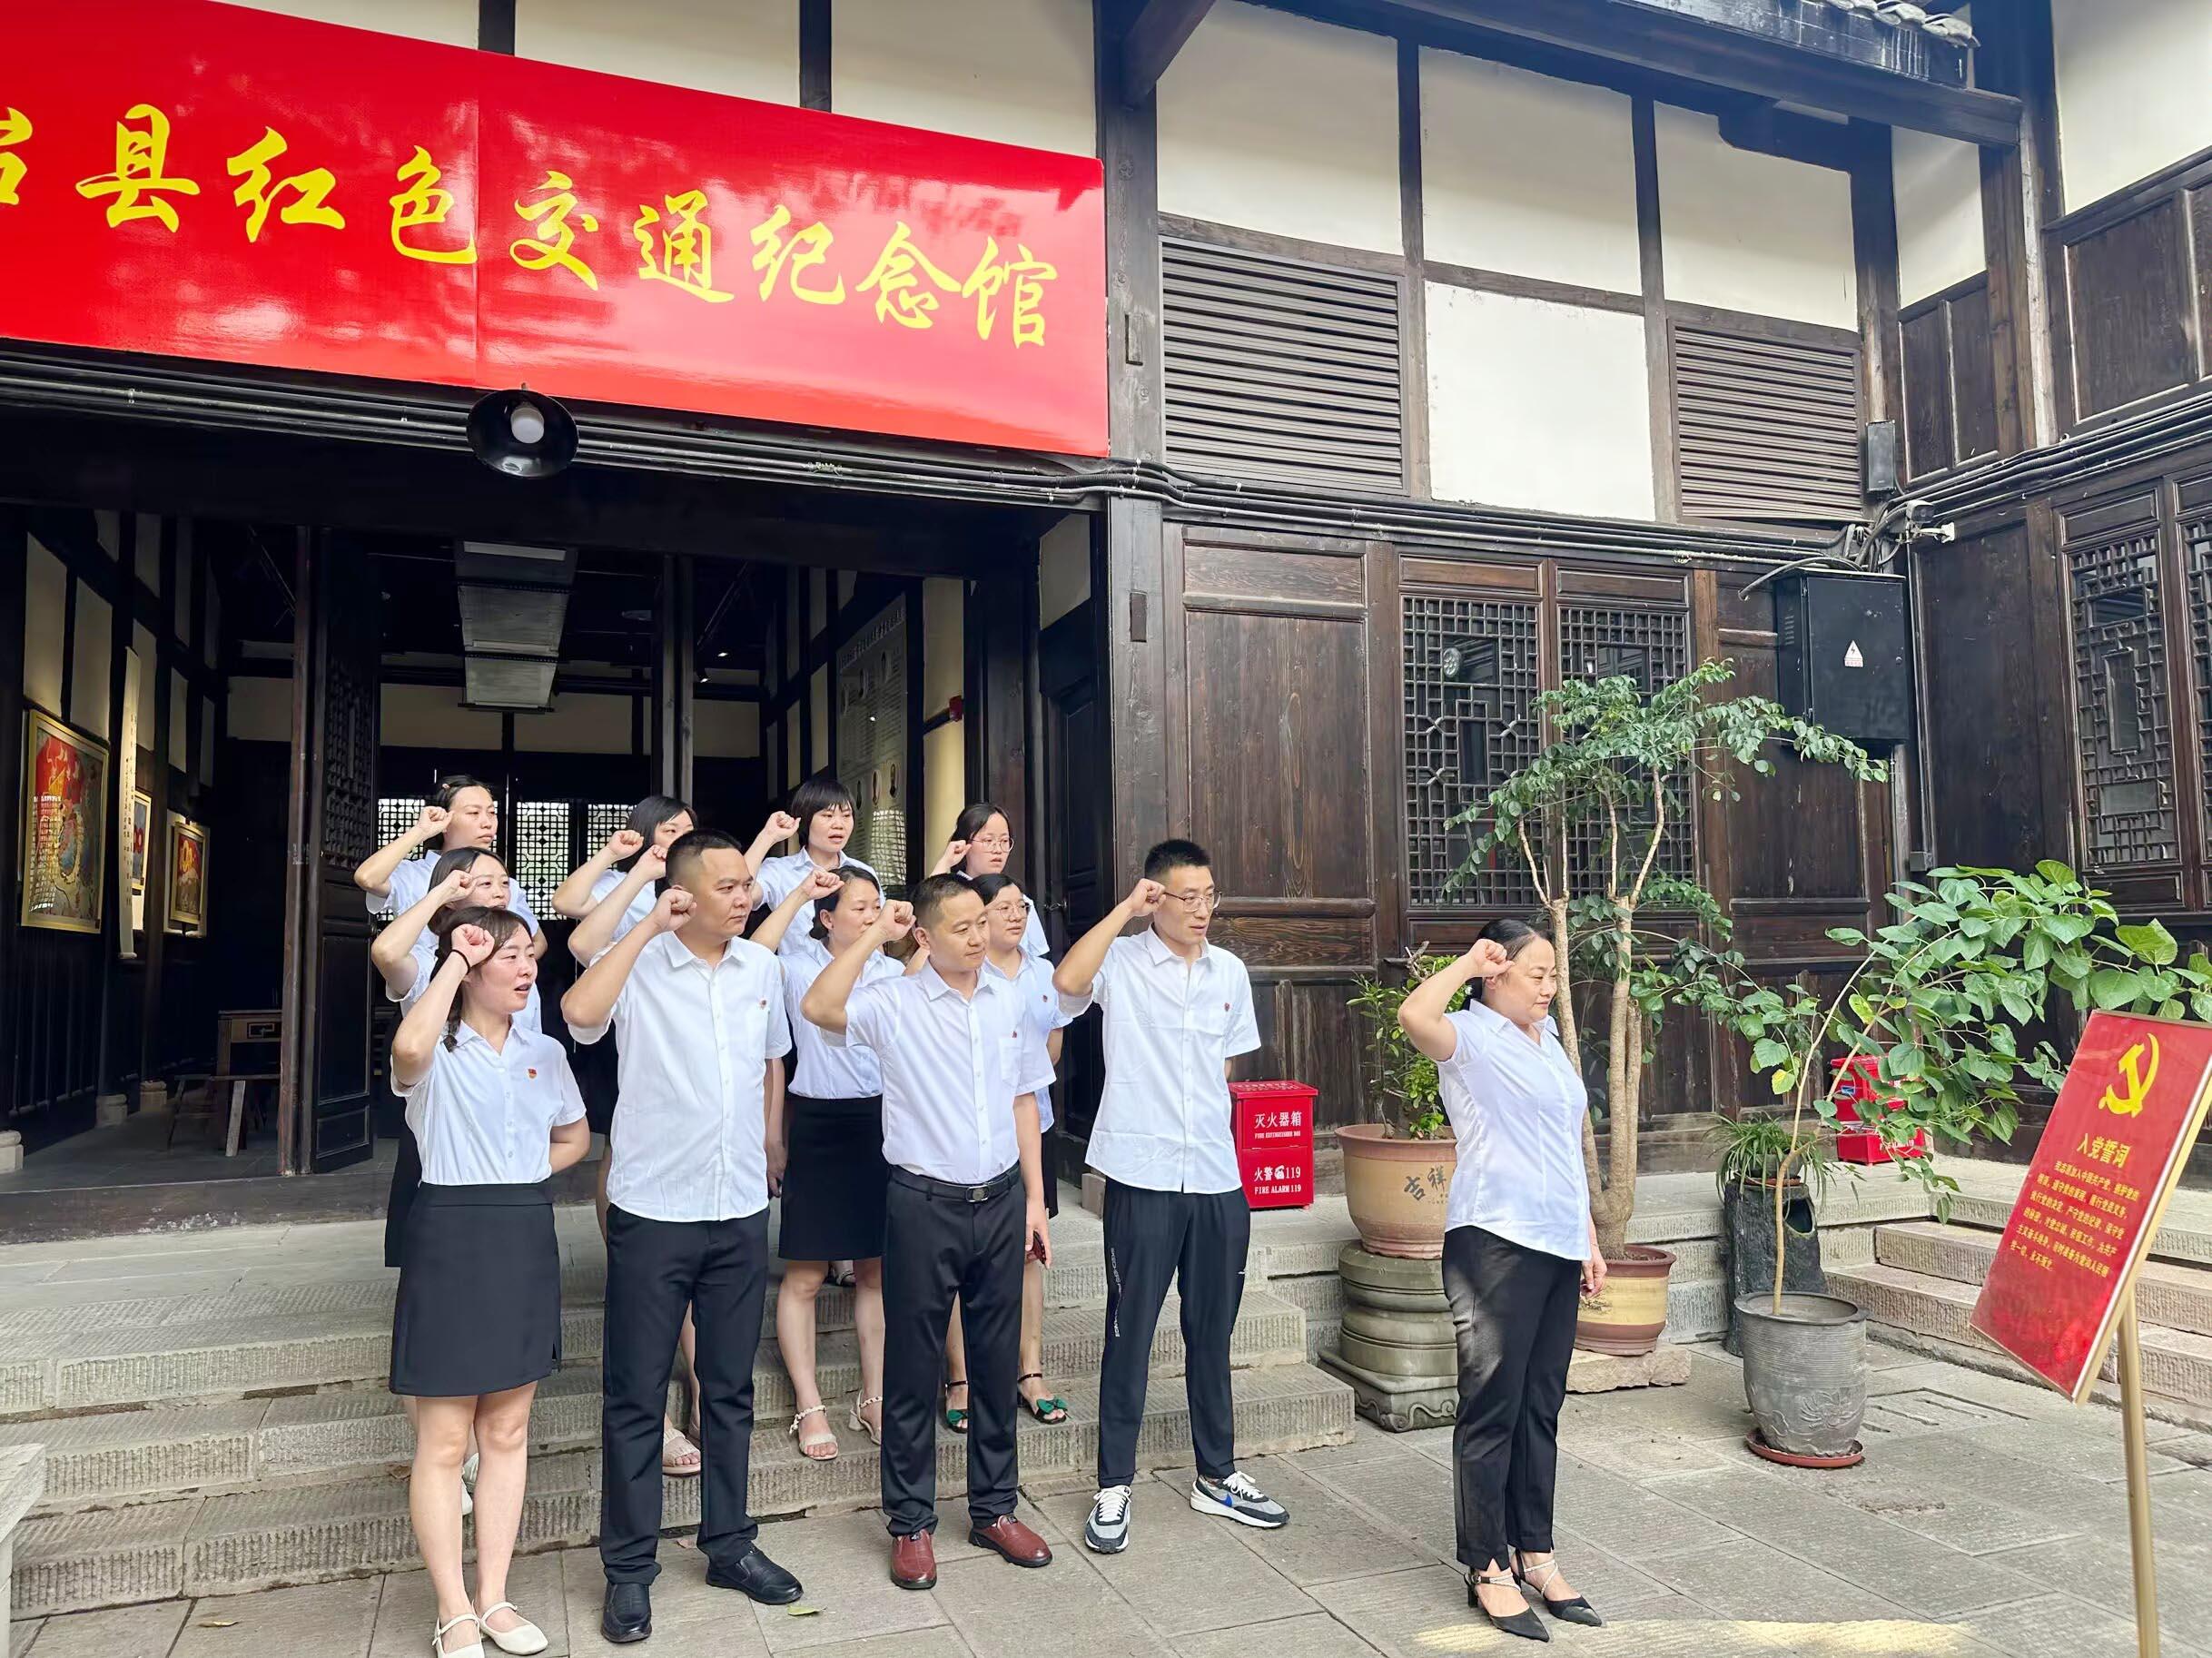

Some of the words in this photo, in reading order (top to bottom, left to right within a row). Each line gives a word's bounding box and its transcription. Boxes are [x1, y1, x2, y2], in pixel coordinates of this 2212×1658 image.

[1254, 1110, 1302, 1129] 灭火器箱
[2077, 1133, 2132, 1169] 入党誓词
[1254, 1166, 1273, 1181] 火警
[1254, 1186, 1270, 1195] FIRE
[1270, 1184, 1290, 1194] ALARM
[1290, 1183, 1302, 1193] 119
